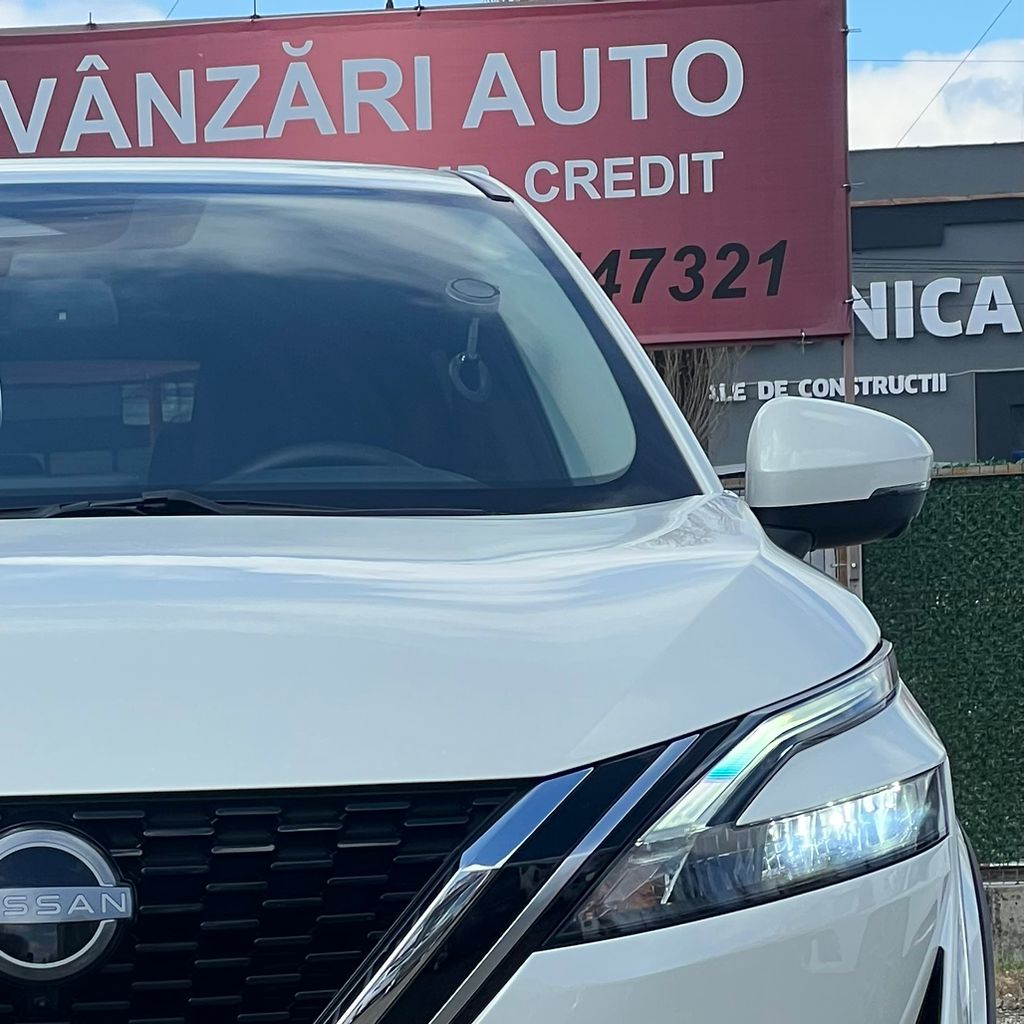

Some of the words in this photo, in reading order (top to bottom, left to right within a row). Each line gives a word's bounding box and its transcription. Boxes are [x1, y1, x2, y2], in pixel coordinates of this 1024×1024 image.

[462, 38, 745, 130] AUTO
[524, 151, 725, 204] CREDIT
[578, 239, 788, 304] 47321
[758, 380, 789, 400] DE
